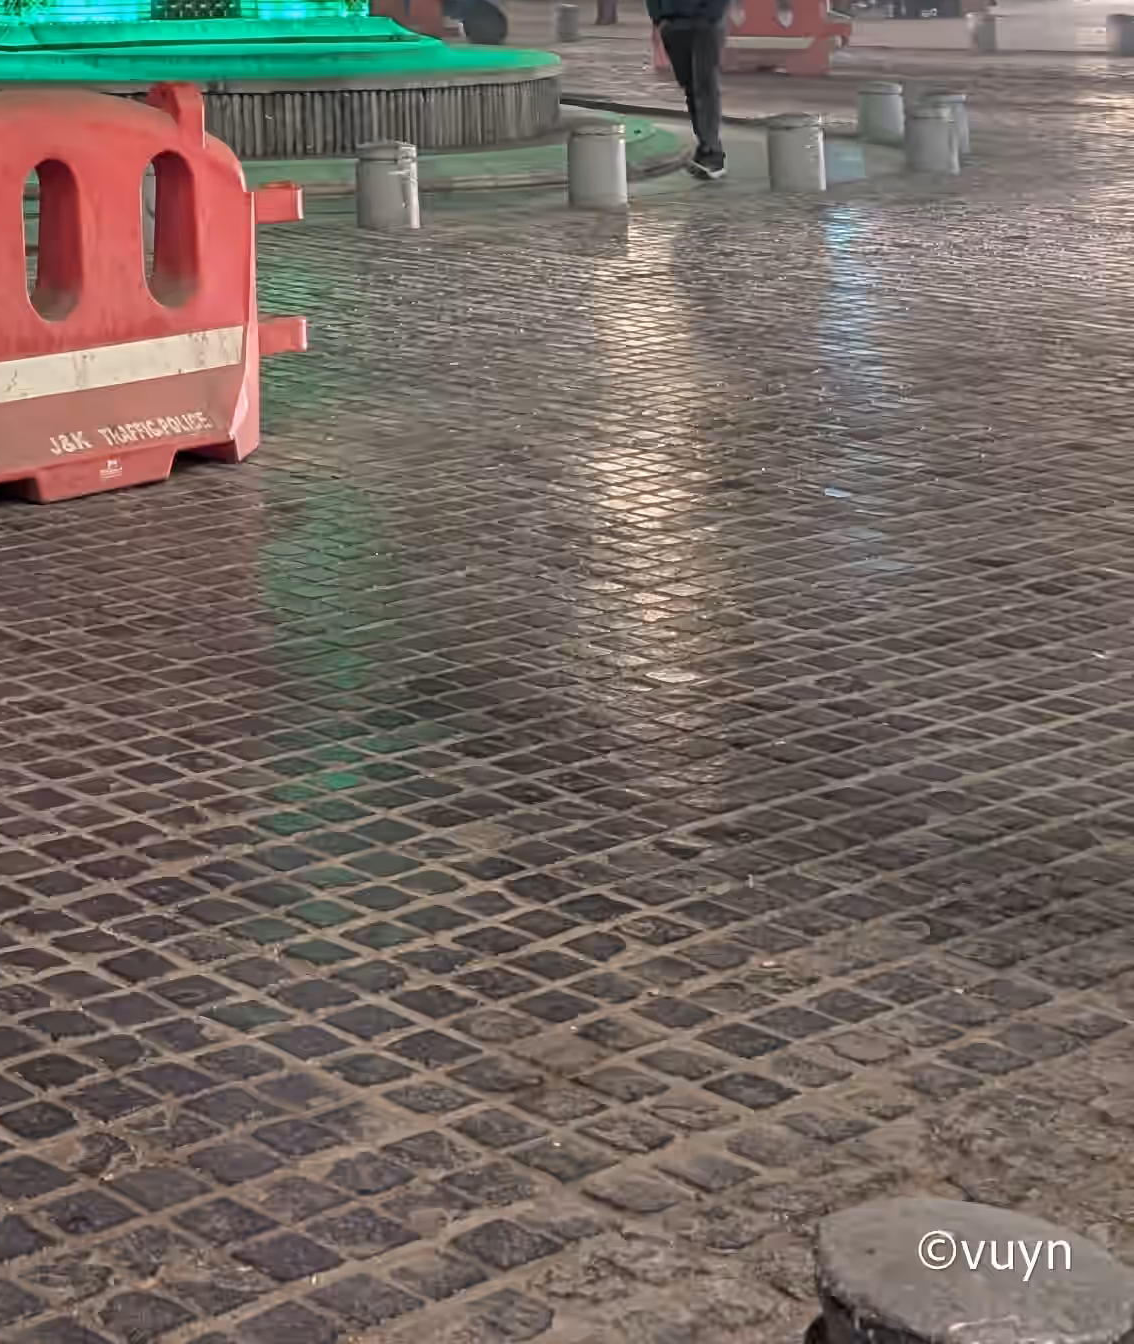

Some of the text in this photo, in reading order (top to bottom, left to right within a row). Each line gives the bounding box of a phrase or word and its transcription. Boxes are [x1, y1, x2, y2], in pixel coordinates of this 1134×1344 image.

[50, 411, 214, 456] J&K TRAFFIC POLICE
